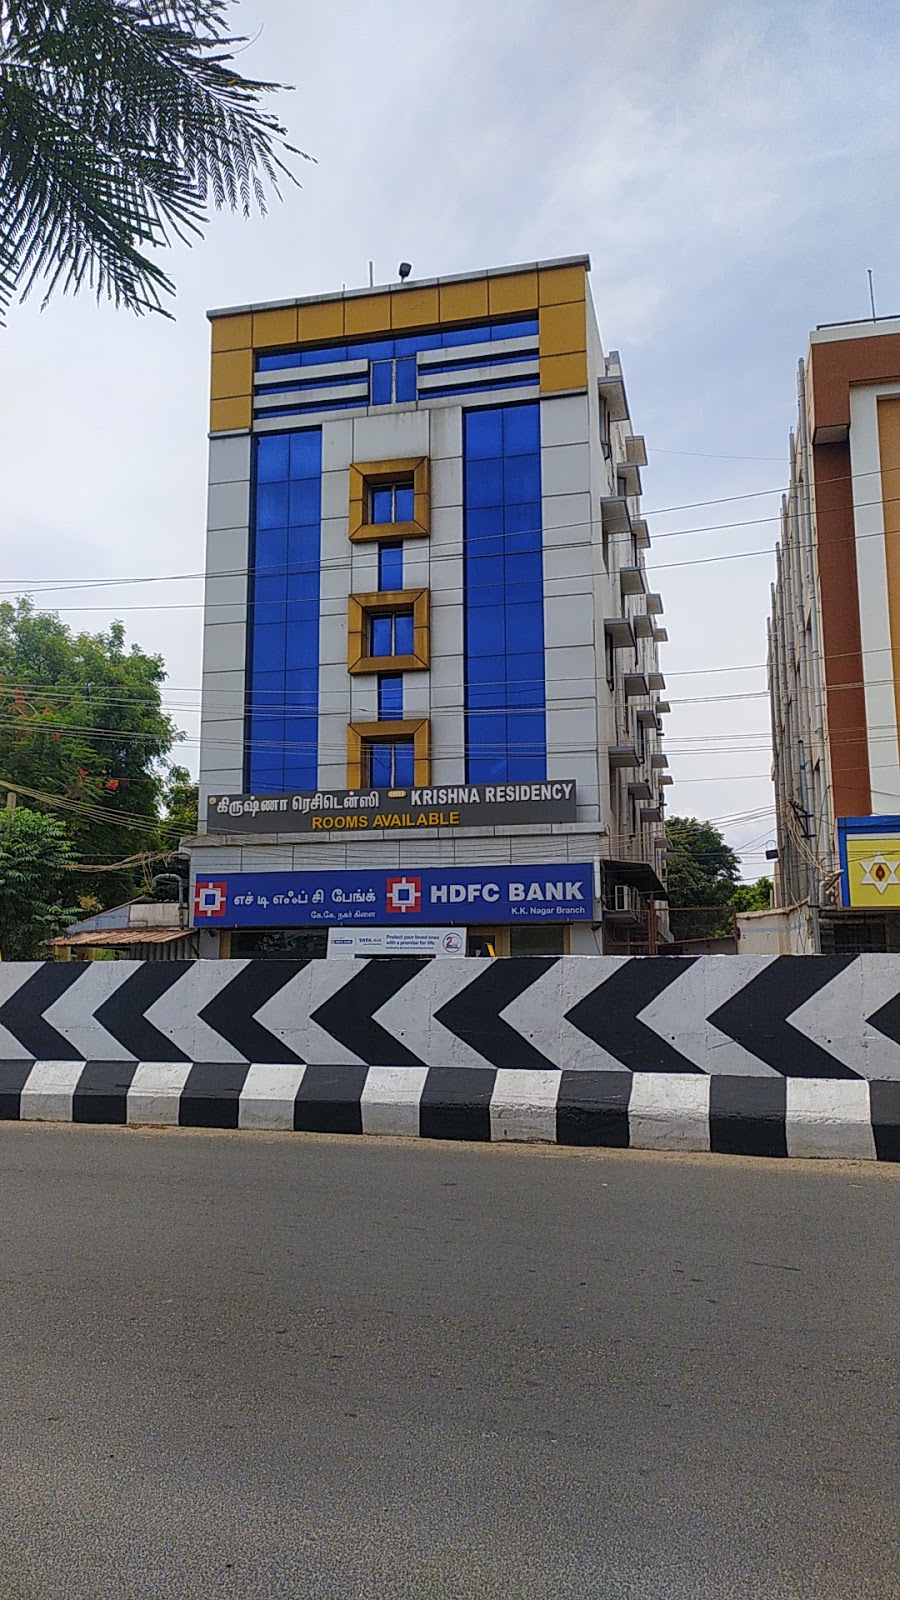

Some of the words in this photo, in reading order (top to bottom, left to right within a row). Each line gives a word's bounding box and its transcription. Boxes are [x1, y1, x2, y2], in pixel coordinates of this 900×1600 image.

[216, 795, 288, 817] கிருஷ்ணா
[292, 791, 380, 814] ரெசிடென்ஸி
[411, 788, 480, 806] KRISHNA
[485, 783, 573, 803] RESIDENCY
[311, 815, 368, 829] ROOMS
[372, 811, 460, 827] AVAILABLE
[233, 891, 254, 906] எச்
[311, 889, 324, 903] சி
[331, 887, 376, 903] பேங்க்
[430, 883, 500, 904] HDFC
[508, 881, 584, 902] BANK
[511, 907, 528, 915] K.K.
[530, 906, 555, 916] Nagar
[556, 905, 586, 914] Branch
